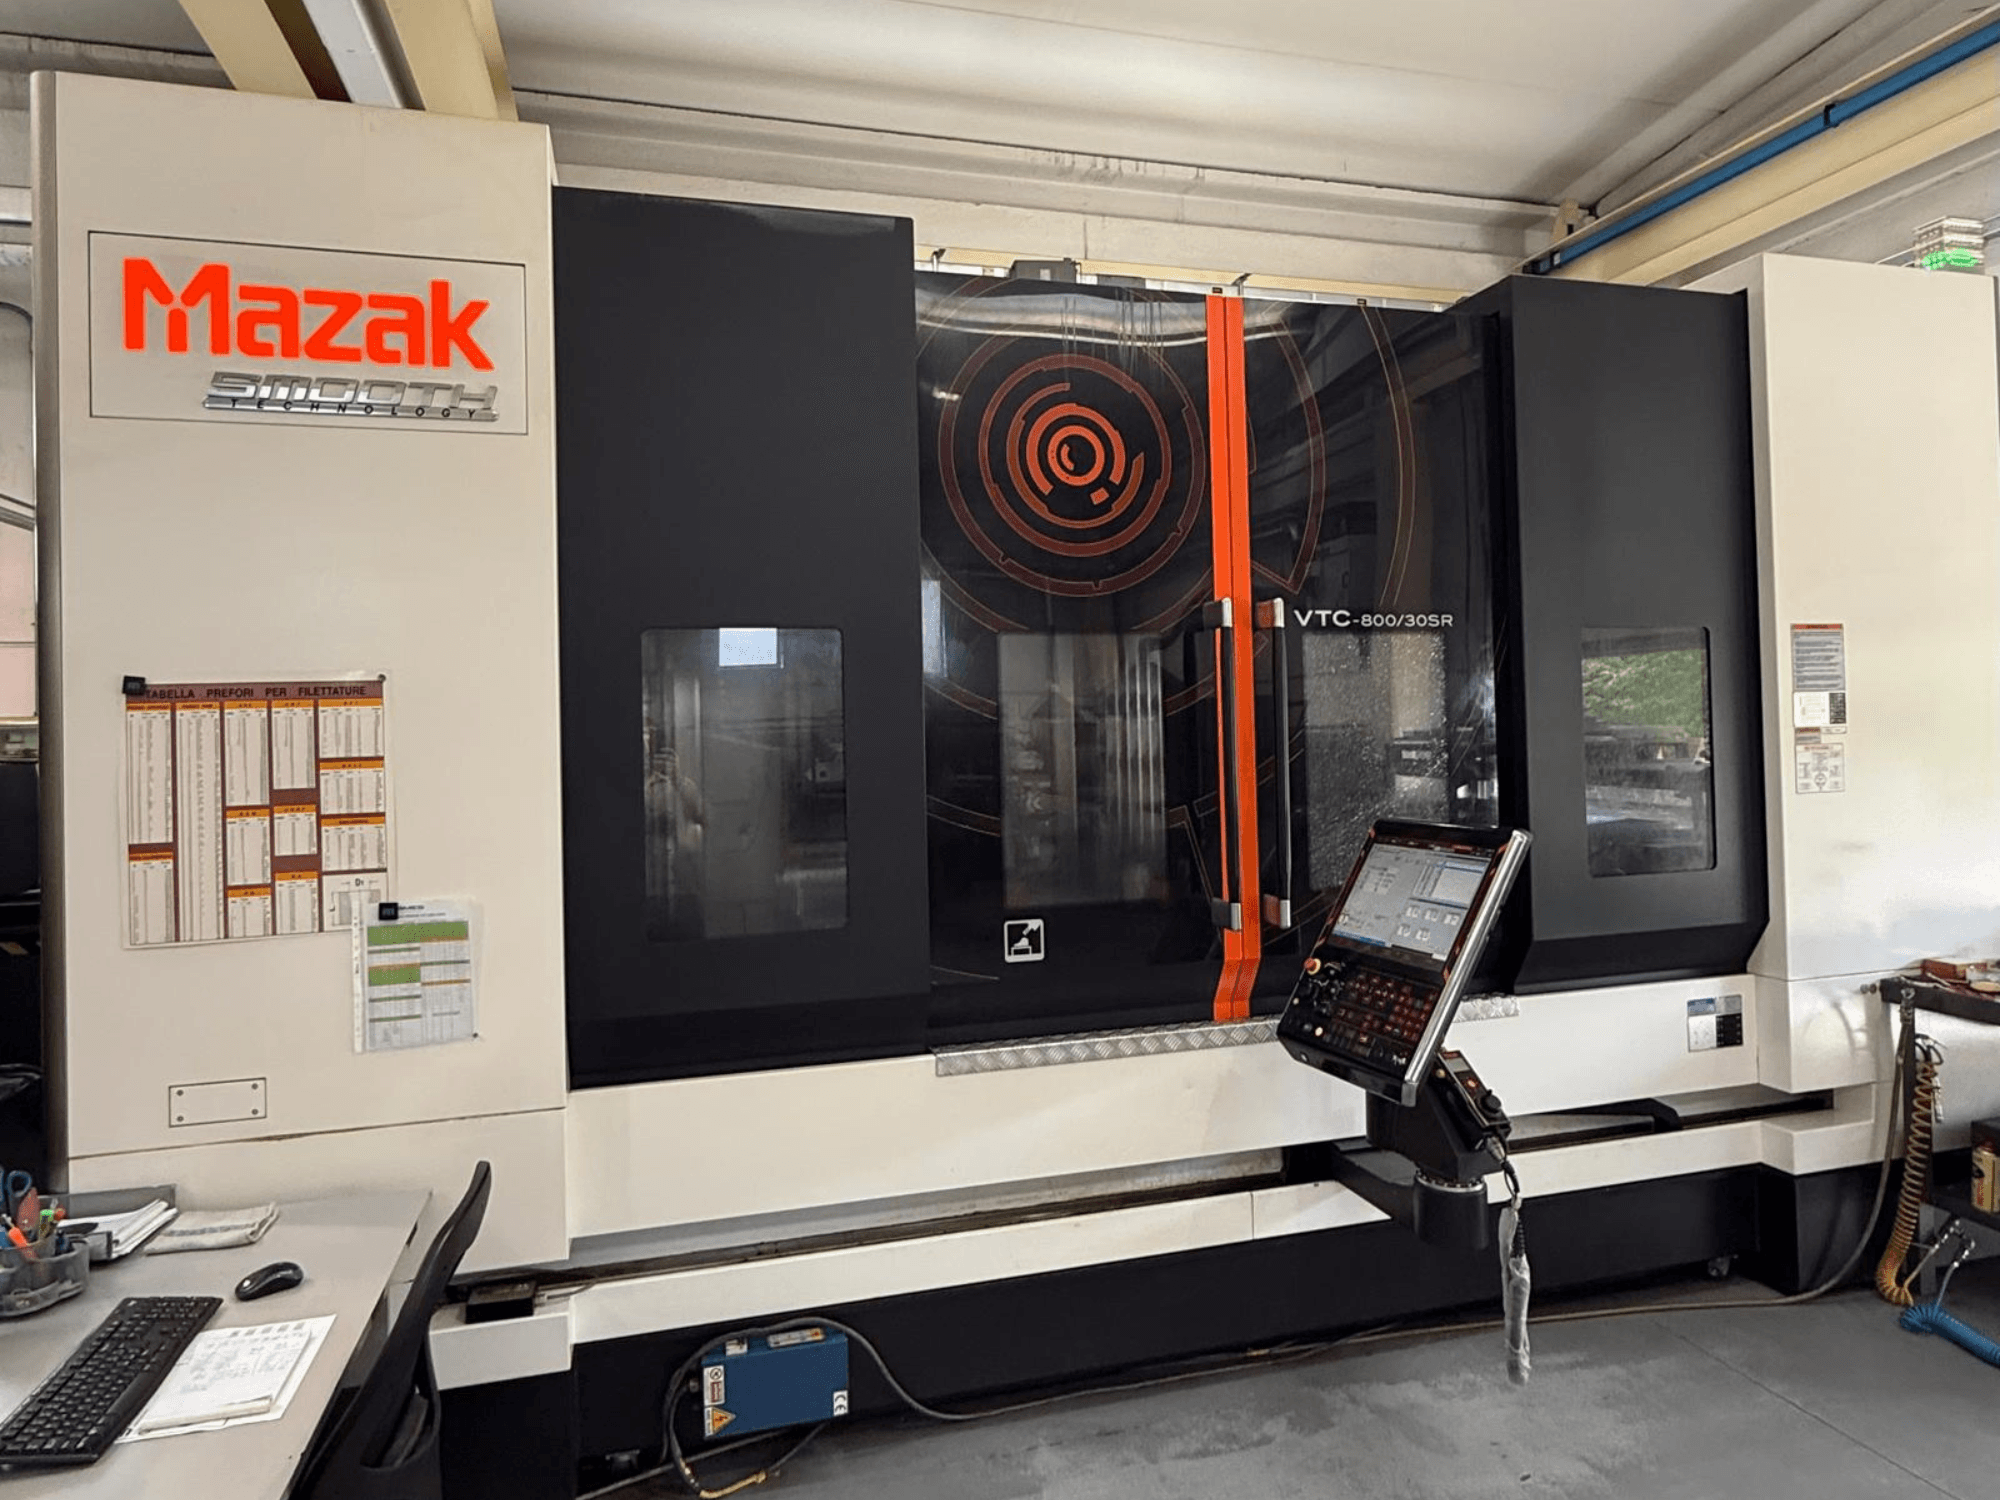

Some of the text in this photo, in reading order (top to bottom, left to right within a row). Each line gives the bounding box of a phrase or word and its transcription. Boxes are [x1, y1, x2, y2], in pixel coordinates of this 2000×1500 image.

[122, 257, 495, 371] Mazak
[206, 371, 498, 410] SMOOTH
[230, 398, 476, 419] TECHNOLOGY
[1293, 609, 1454, 628] VTC-800/30SR
[145, 685, 367, 699] TABELLA PREFORI PER FILETTATURE
